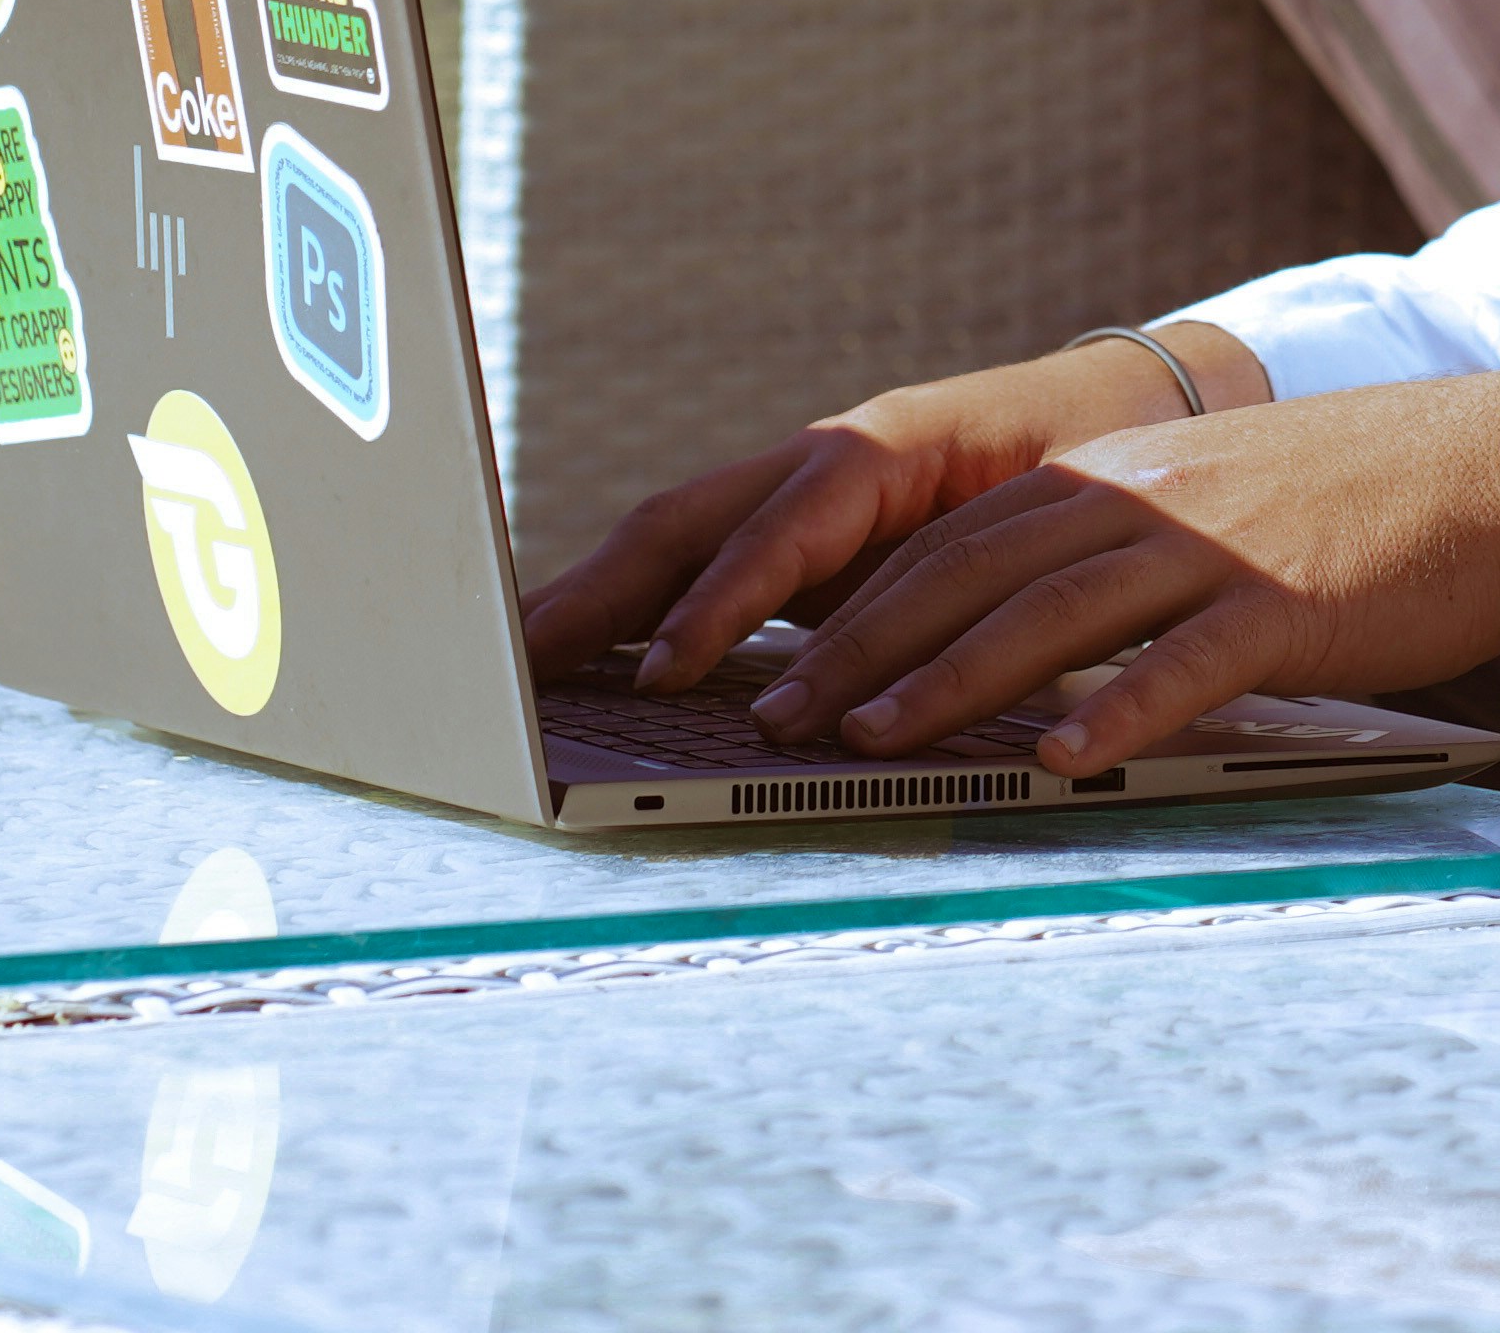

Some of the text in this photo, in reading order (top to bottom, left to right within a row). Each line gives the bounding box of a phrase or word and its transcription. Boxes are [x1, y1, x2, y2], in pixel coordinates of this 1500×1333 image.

[268, 0, 370, 57] THUNDER
[156, 71, 237, 140] Coke
[301, 224, 347, 333] Ps
[11, 307, 68, 351] CRAPPY
